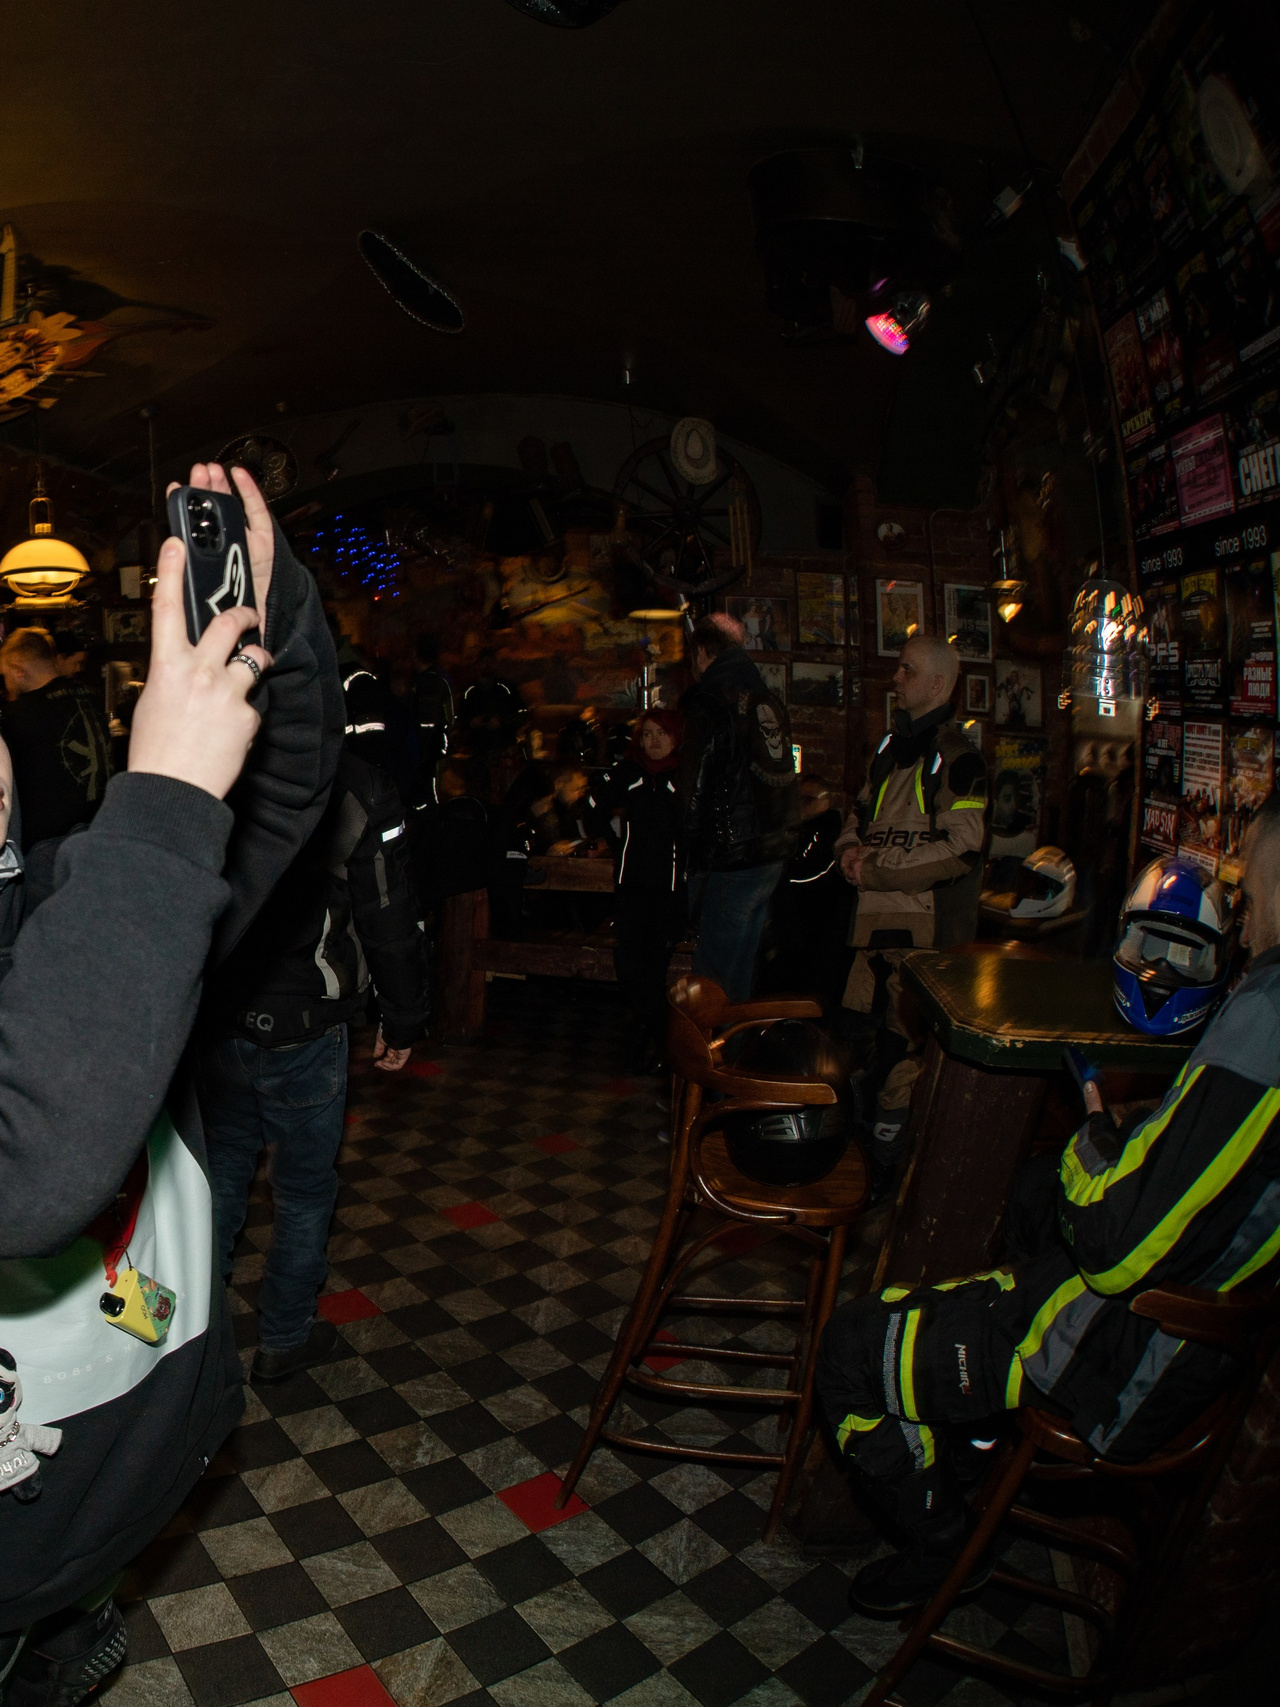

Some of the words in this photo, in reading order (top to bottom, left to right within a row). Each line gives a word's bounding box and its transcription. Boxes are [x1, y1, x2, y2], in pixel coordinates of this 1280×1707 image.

[1215, 537, 1239, 557] since
[1241, 525, 1267, 548] 1993
[1141, 557, 1161, 574] since
[1162, 547, 1183, 570] 1993
[1243, 666, 1272, 682] РАЗНЫЕ
[1247, 682, 1270, 699] ЛЮДИ
[242, 1010, 274, 1032] EQ
